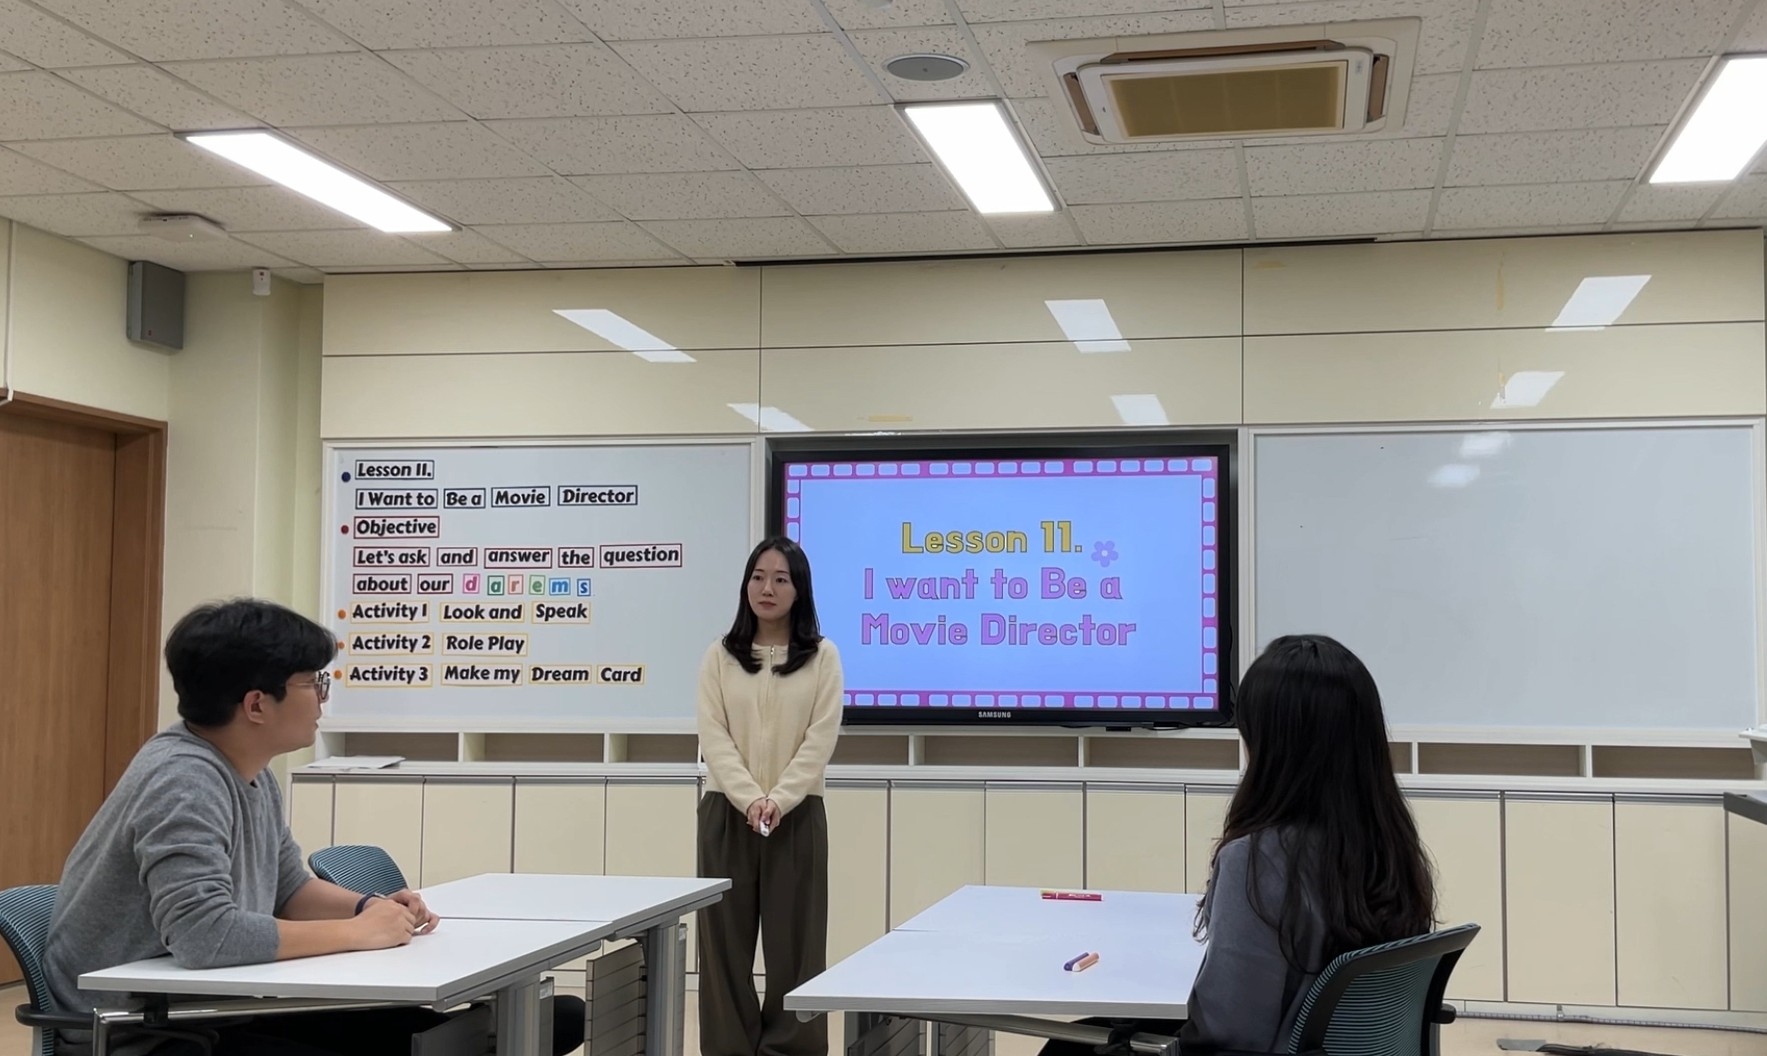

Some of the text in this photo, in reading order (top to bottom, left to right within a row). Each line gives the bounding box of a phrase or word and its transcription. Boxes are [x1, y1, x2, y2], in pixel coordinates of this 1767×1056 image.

[358, 463, 412, 477] Lesson
[358, 487, 634, 506] I Want to Be a Movie Director
[357, 518, 437, 537] Objective
[902, 521, 1028, 554] Lesson
[357, 547, 679, 565] Let's ask and answer the question
[357, 577, 408, 591] about
[420, 580, 450, 591] our
[863, 567, 1123, 600] I want to Be a
[352, 602, 418, 621] Activity
[444, 605, 485, 619] Look
[489, 604, 523, 619] and
[536, 603, 588, 621] Speak
[861, 613, 1137, 646] Movie Director
[352, 634, 525, 654] Activity 2 Role Play
[350, 665, 642, 684] Activity 3 Make my Dream Card
[978, 711, 1012, 719] SAMSUNG
